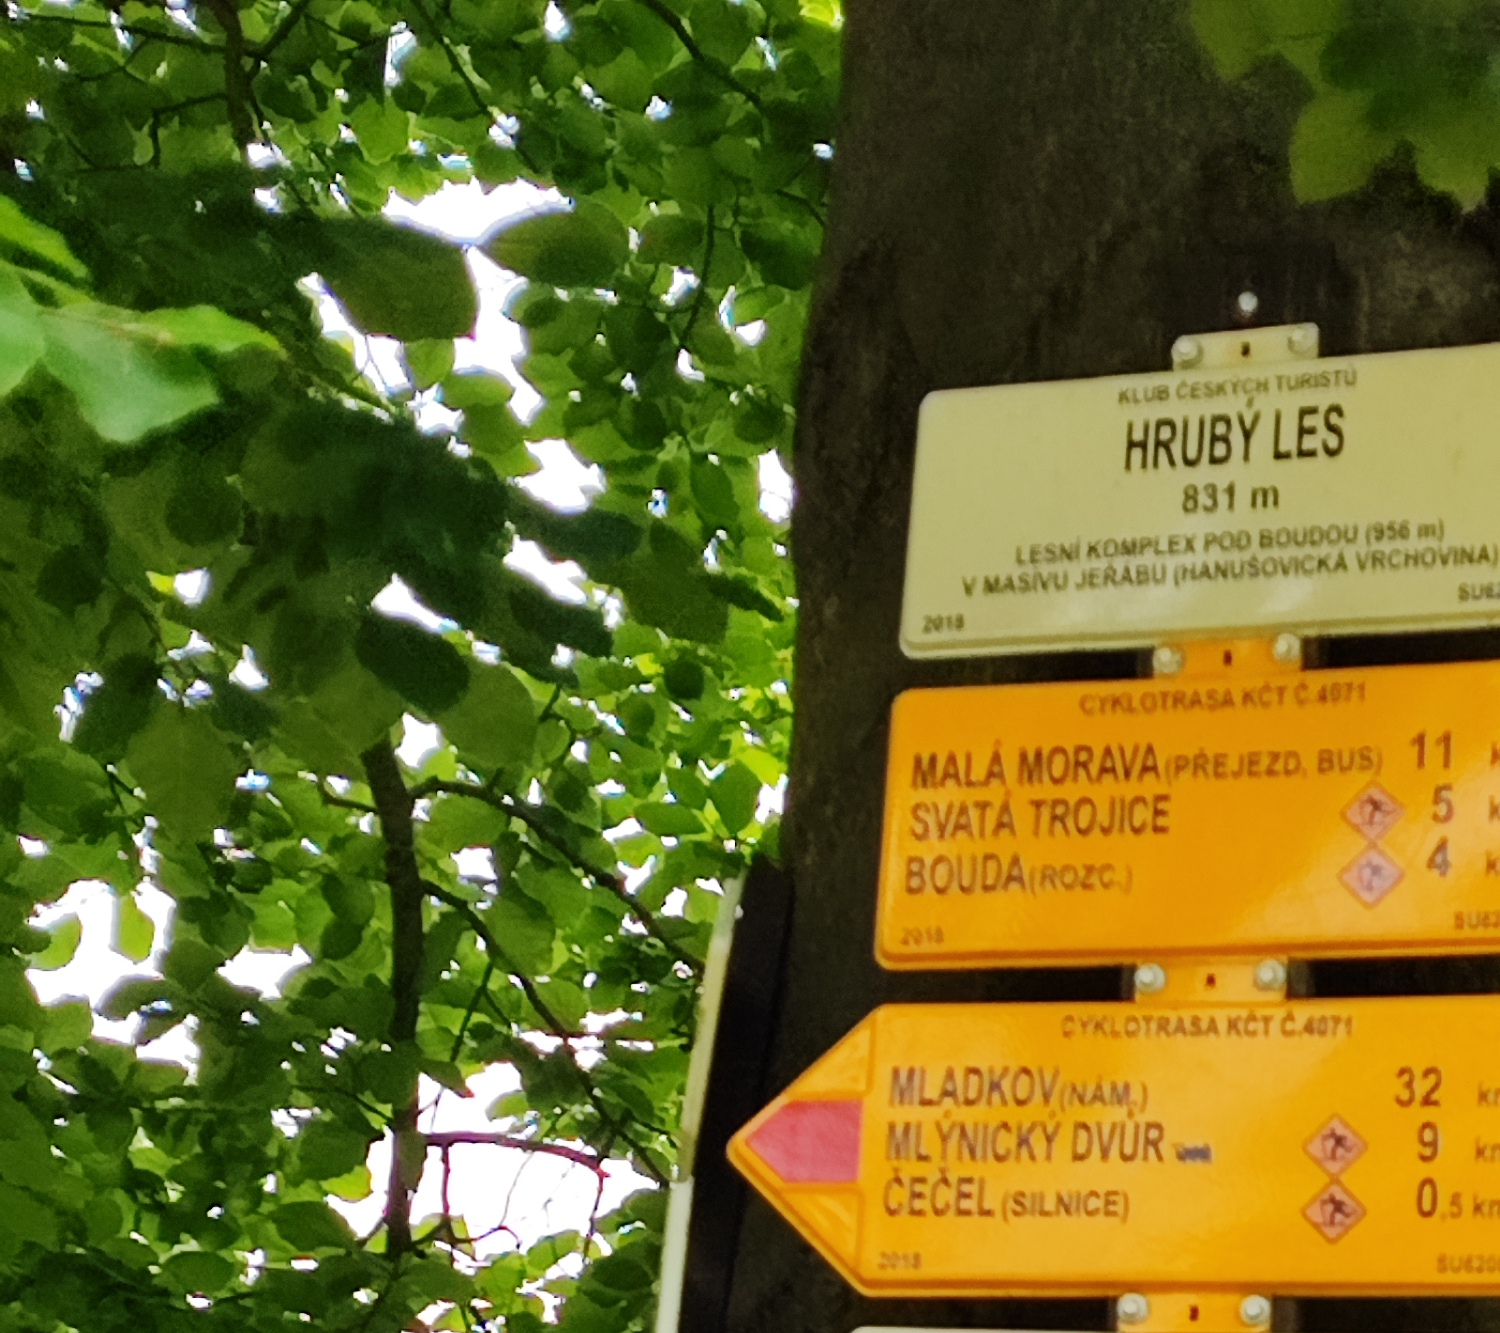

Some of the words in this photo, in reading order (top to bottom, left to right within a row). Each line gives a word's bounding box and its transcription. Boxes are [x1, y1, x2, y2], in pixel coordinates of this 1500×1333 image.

[1118, 384, 1170, 405] KLUB
[1125, 396, 1261, 472] HRUBÝ
[1273, 403, 1346, 460] LES
[1182, 481, 1236, 514] 831
[1250, 484, 1279, 510] m
[961, 575, 977, 598] V
[1355, 543, 1499, 572] VRCHOVINA)
[1015, 535, 1081, 566] LESNÍ
[1086, 533, 1197, 561] KOMPLEX
[1203, 529, 1252, 556] POD
[1259, 524, 1359, 549] BOUDOU
[1078, 687, 1236, 717] CYKLOTRASA
[1241, 680, 1288, 709] KČT
[911, 738, 1007, 790] MALÁ
[1017, 741, 1161, 786] MORAVA
[1317, 745, 1383, 777] BUS)
[1409, 729, 1452, 770] 11
[910, 788, 1017, 842] SVATÁ
[1028, 793, 1171, 838] TROJICE
[1432, 782, 1455, 824] 5
[904, 852, 1027, 896] BOUDA
[1426, 836, 1451, 877] 4
[1060, 1013, 1220, 1040] CYKLOTRASA
[1226, 1010, 1274, 1038] KČT
[889, 1064, 1061, 1109] MLADKOV
[1394, 1066, 1442, 1108] 32
[885, 1109, 1062, 1164] MLÝNICKÝ
[1071, 1107, 1165, 1164] DVŮR
[1417, 1120, 1440, 1163] 9
[882, 1166, 995, 1219] ČEČEL
[1001, 1189, 1130, 1226] (SILNICE)
